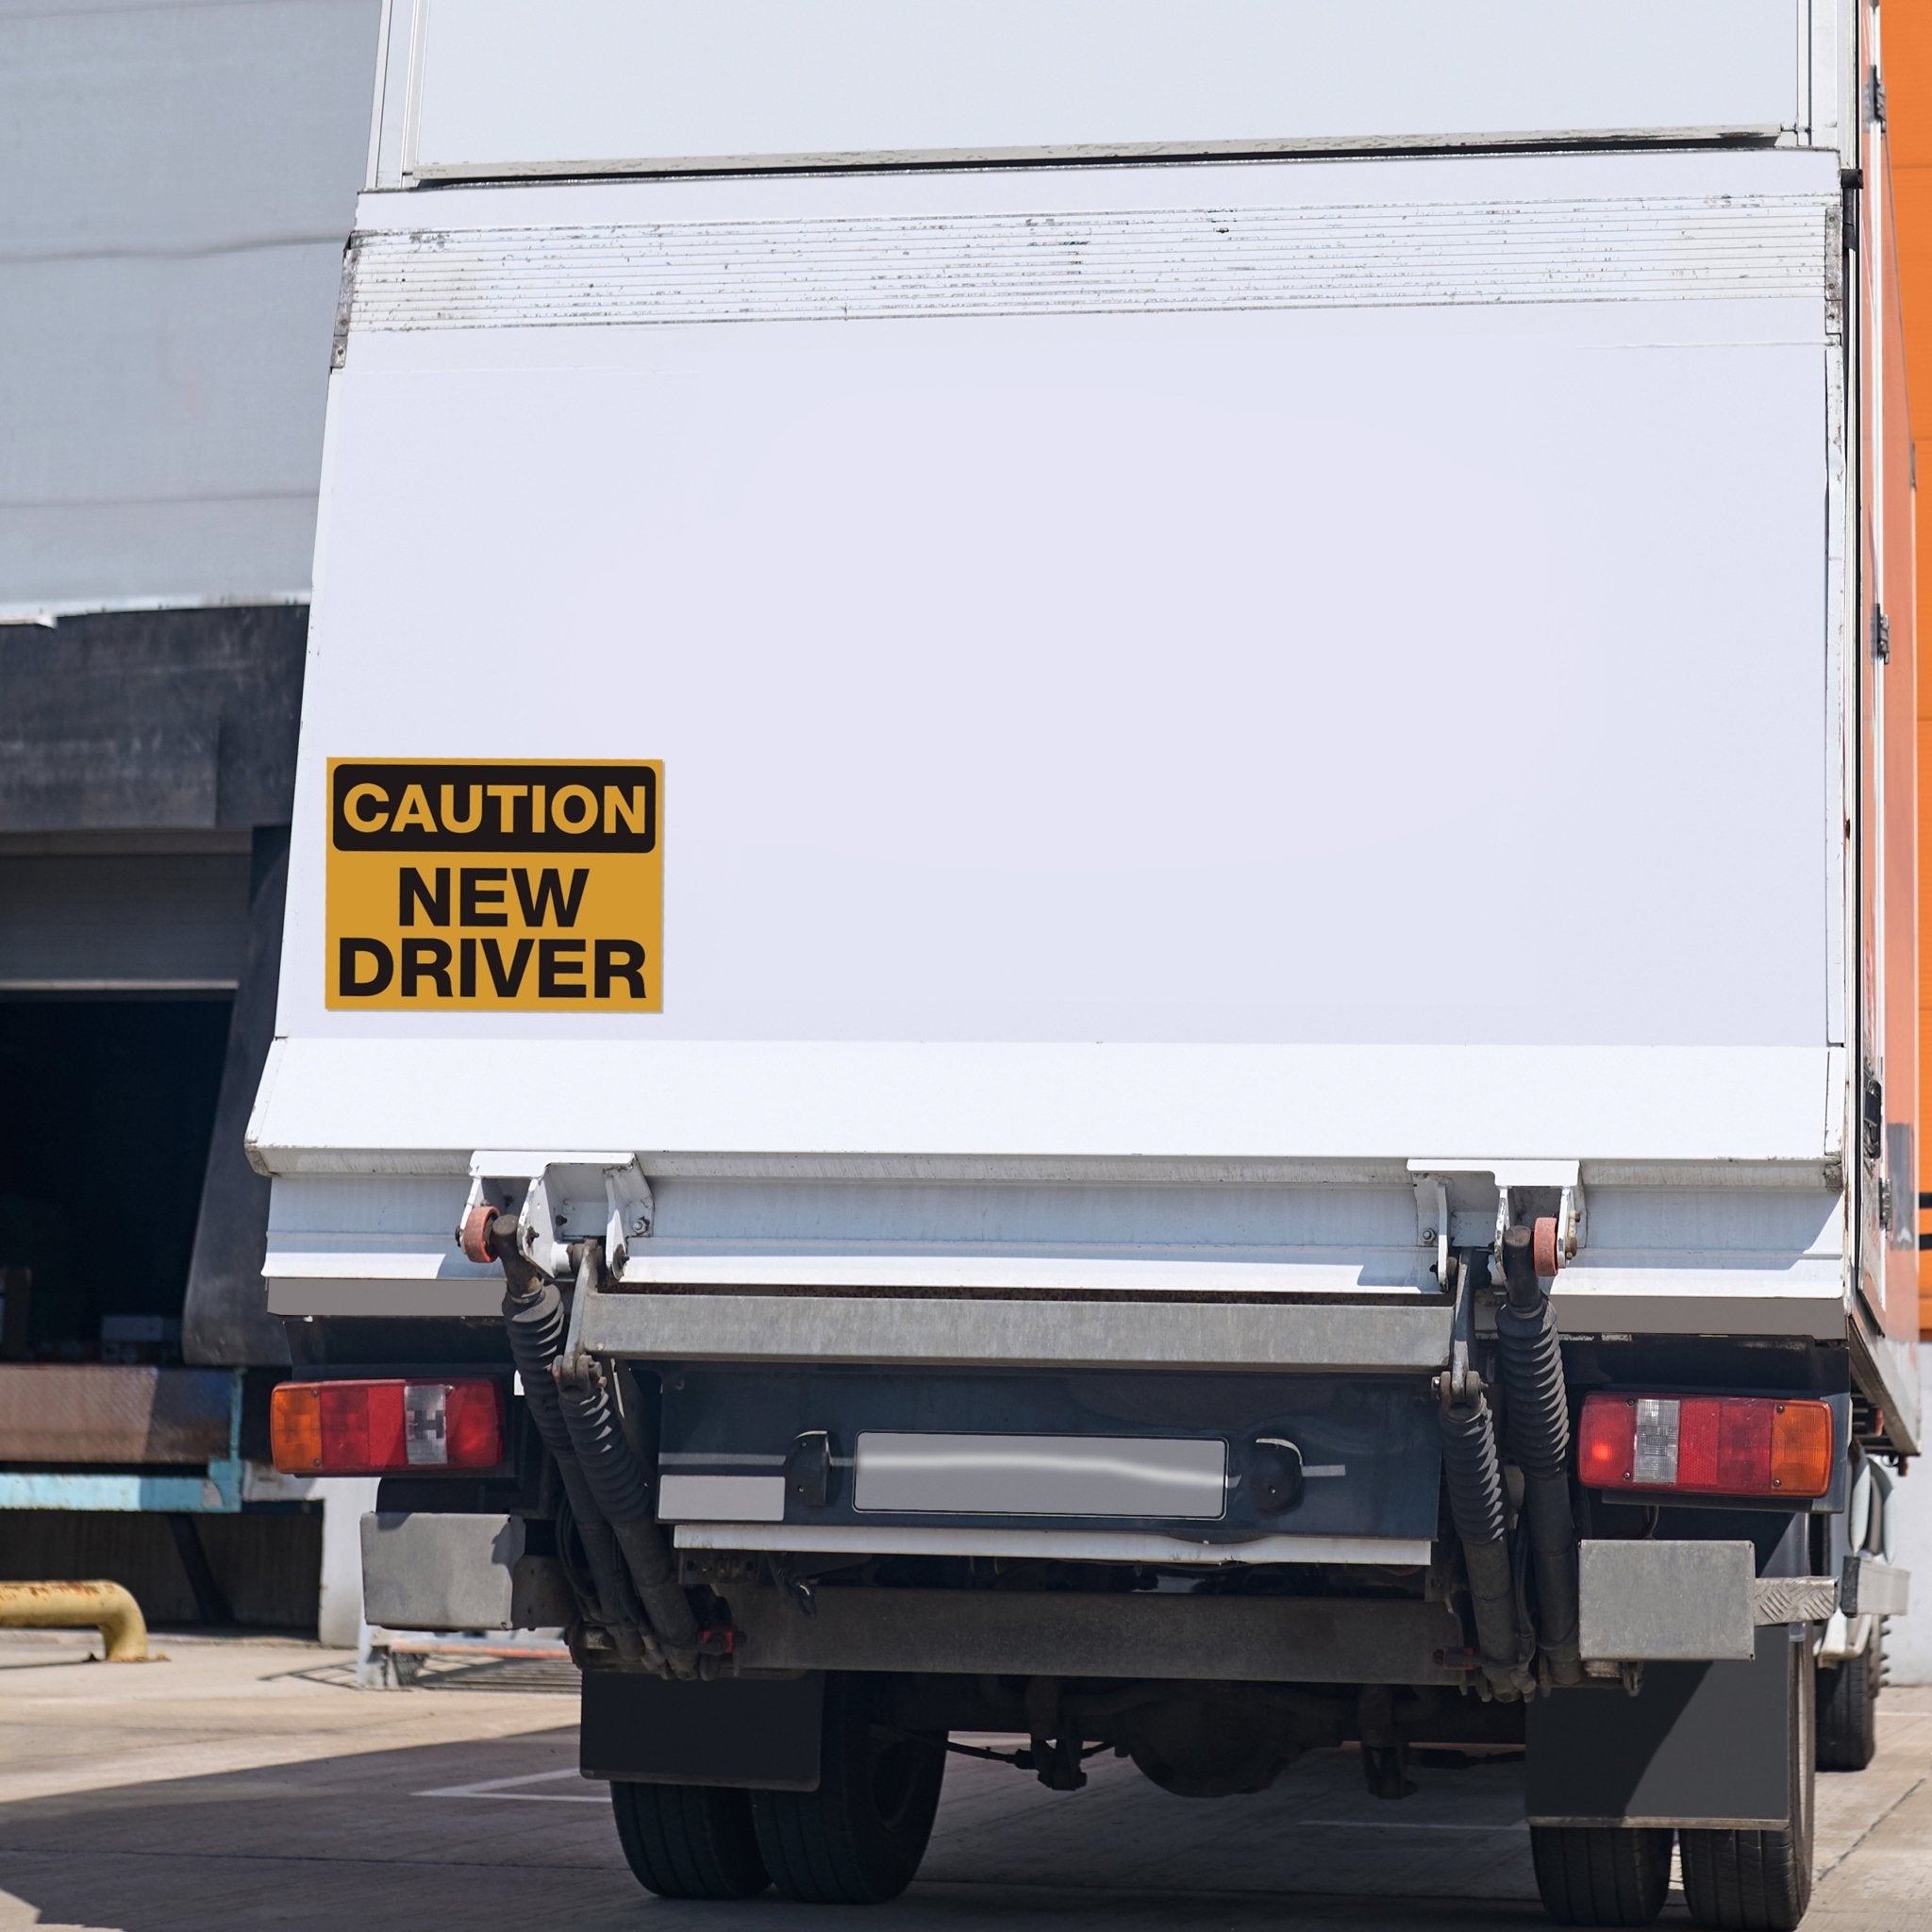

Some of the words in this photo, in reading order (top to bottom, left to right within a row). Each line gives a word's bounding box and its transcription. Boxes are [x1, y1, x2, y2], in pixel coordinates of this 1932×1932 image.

[343, 783, 646, 834] CAUTION
[399, 867, 590, 927] NEW
[339, 937, 647, 998] DRIVER
